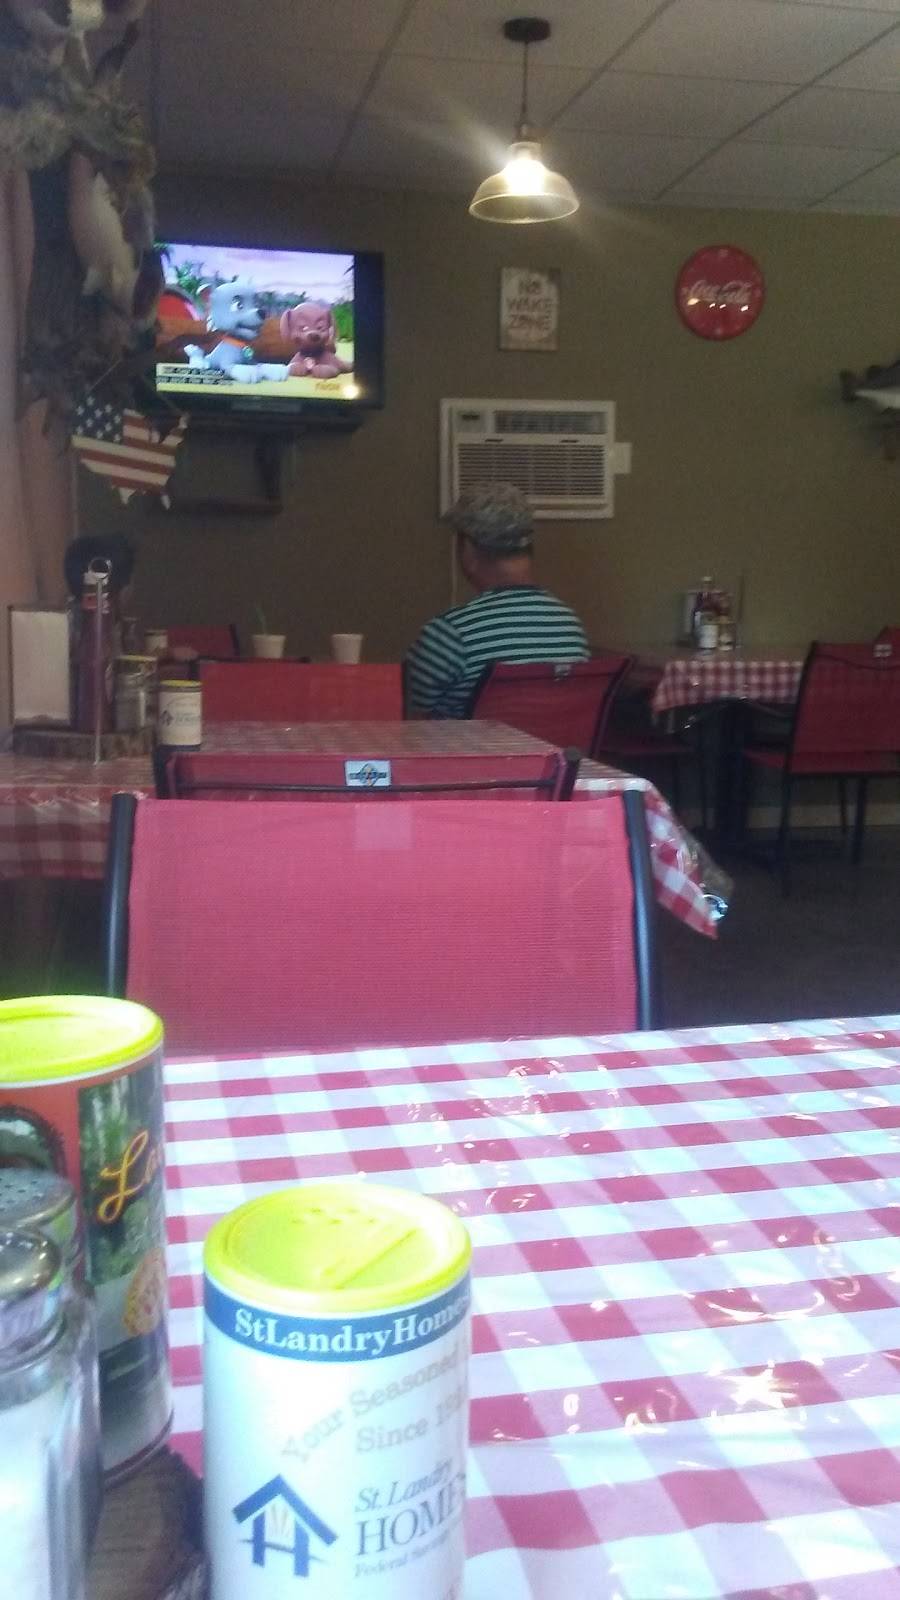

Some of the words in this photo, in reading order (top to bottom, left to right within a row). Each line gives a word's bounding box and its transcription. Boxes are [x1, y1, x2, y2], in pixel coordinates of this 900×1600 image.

[506, 298, 553, 317] WAKE
[506, 314, 552, 331] ZONE
[356, 1418, 429, 1453] Since
